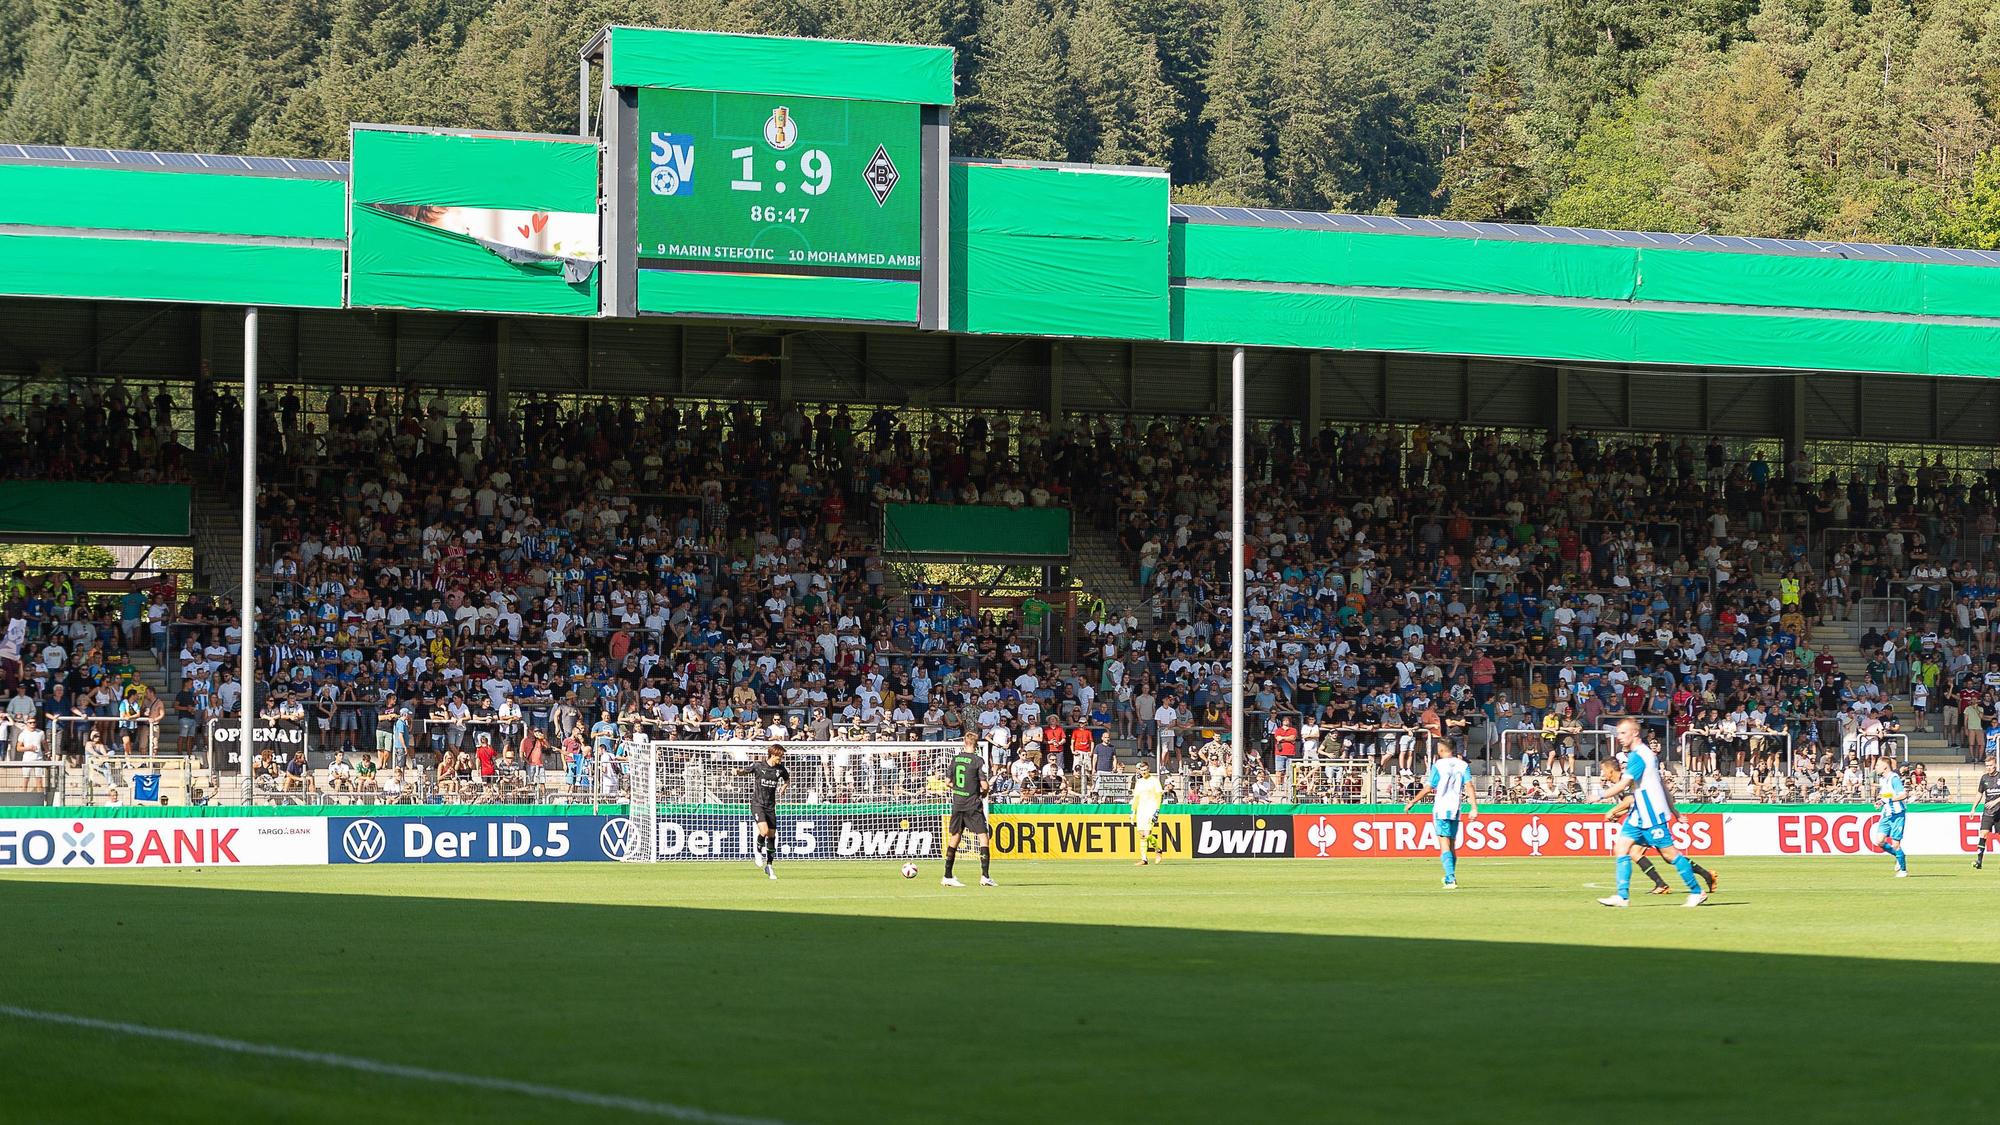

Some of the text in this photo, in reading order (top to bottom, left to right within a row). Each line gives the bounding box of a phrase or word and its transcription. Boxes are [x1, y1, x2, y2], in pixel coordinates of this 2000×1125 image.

[750, 205, 810, 223] 86:47
[657, 243, 774, 260] 9 MARIN STEFOTIC
[789, 250, 804, 261] 10
[807, 250, 885, 265] MOHAMMED
[214, 727, 302, 744] OPENAU
[956, 764, 966, 788] 6
[104, 828, 239, 864] BANK
[403, 822, 570, 858] Der ID.5
[658, 821, 729, 855] Der
[837, 820, 933, 855] bwin
[1197, 819, 1288, 854] bwin
[1564, 820, 1712, 850] STRSS
